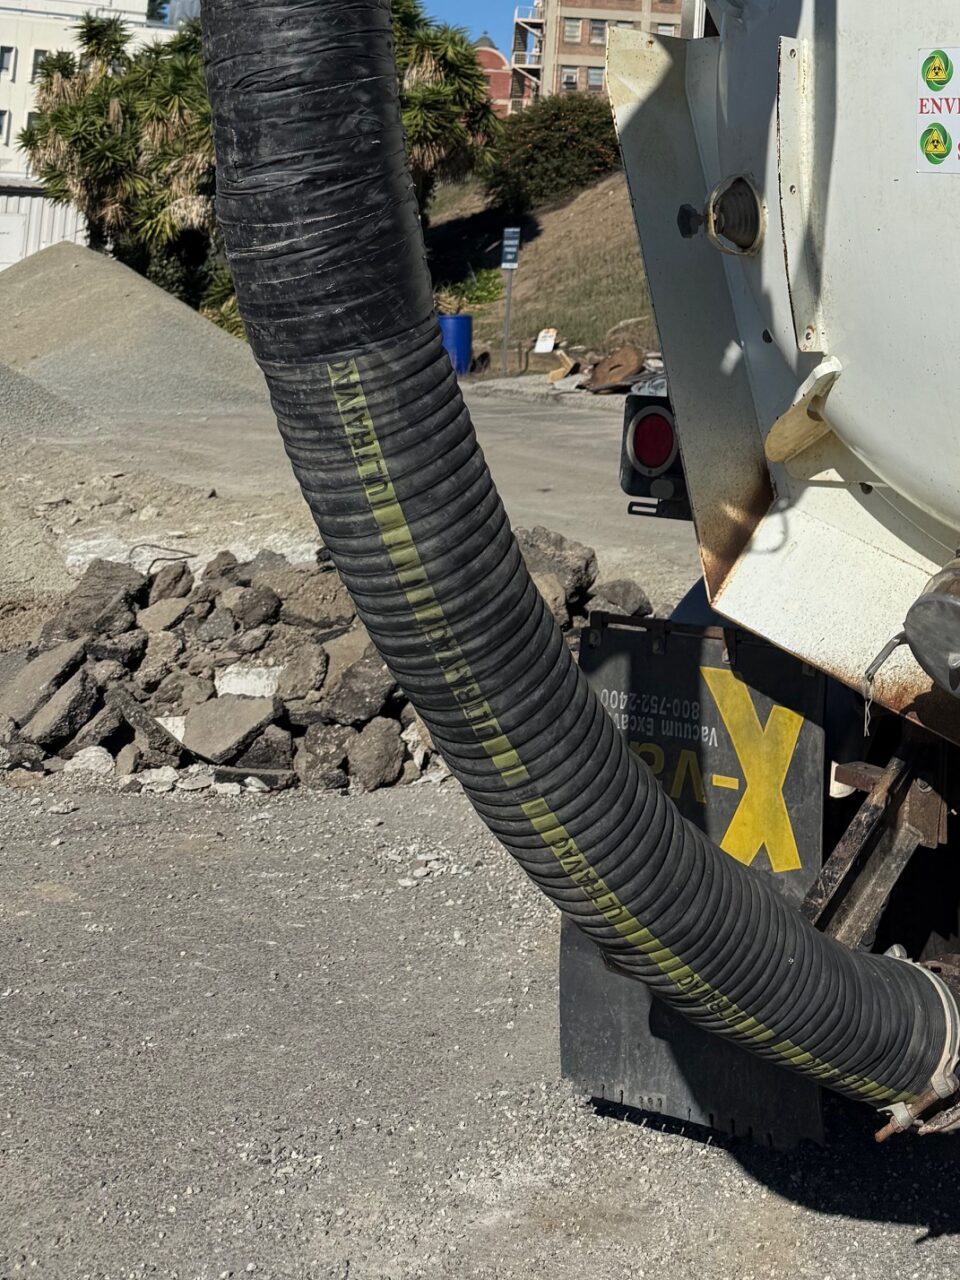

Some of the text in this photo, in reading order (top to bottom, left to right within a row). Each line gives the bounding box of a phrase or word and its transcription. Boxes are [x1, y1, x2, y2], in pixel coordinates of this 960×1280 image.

[600, 688, 700, 720] 800-752-2400
[608, 711, 719, 747] Vacuum Excav
